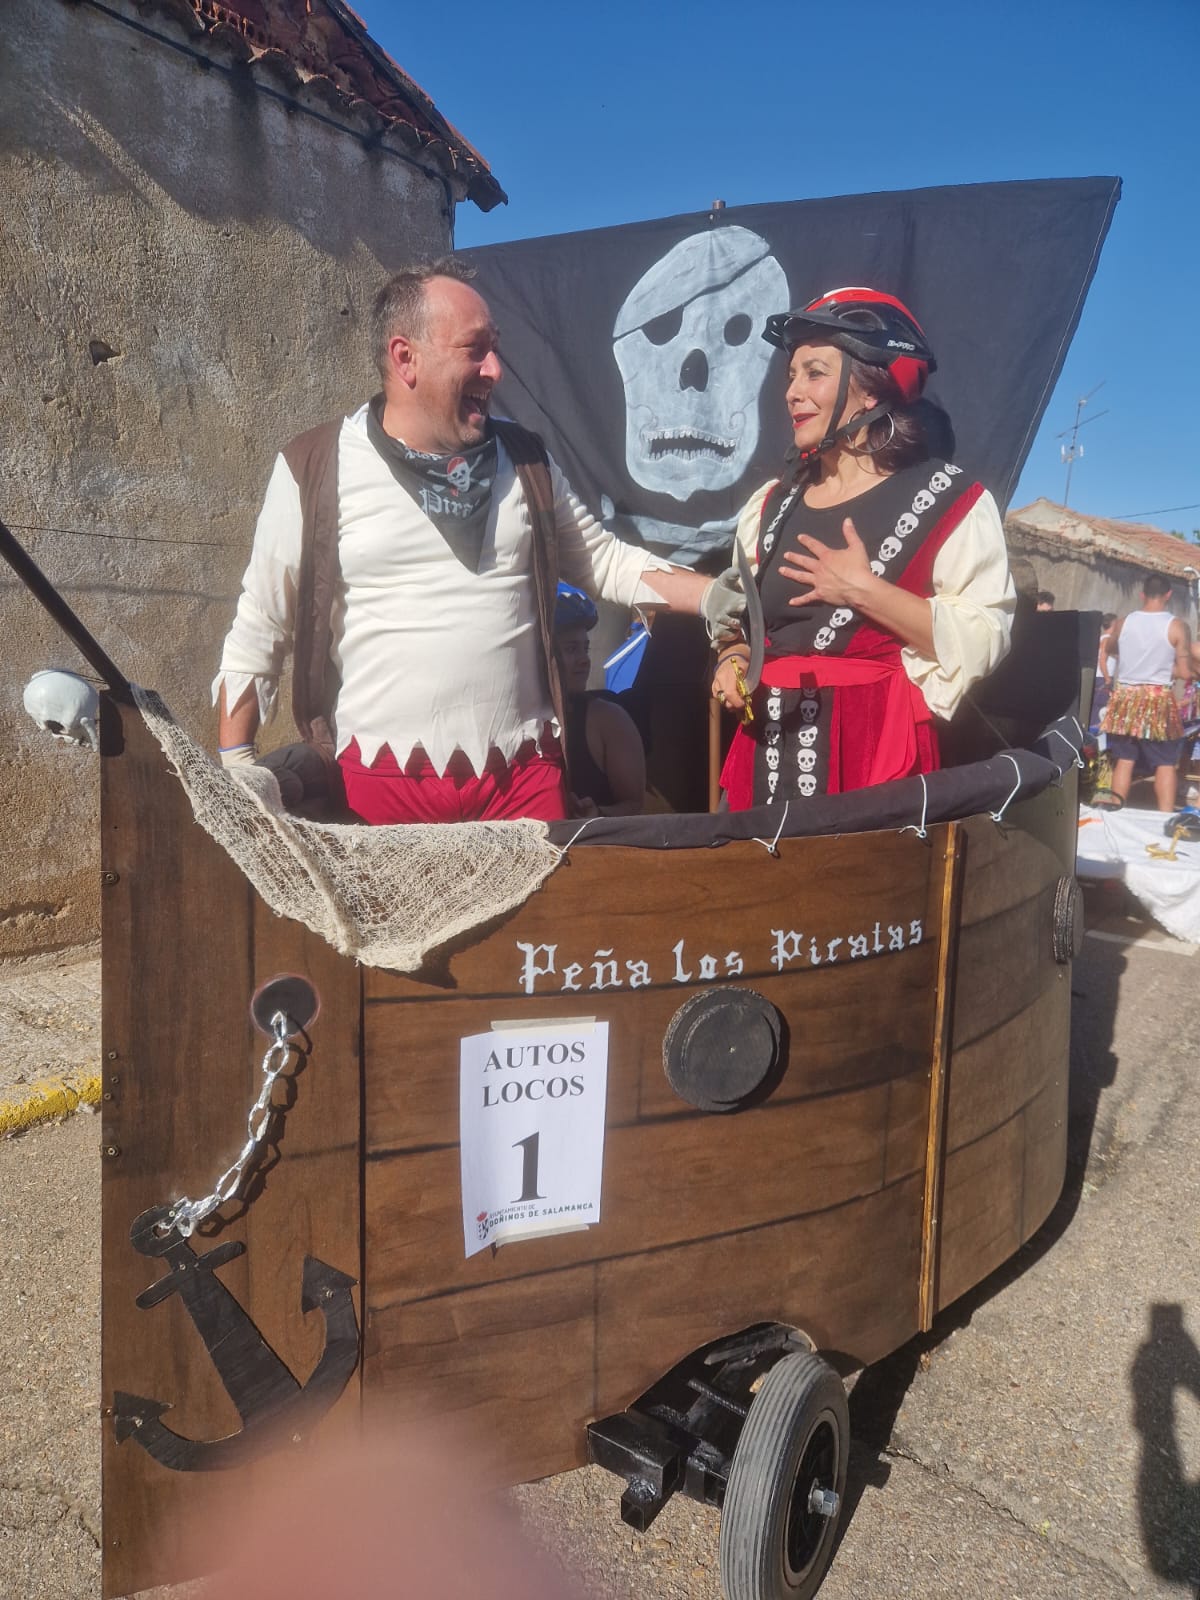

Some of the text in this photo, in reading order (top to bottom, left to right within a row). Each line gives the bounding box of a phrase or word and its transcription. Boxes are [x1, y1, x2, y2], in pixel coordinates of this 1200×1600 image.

[516, 940, 652, 994] Peña
[770, 919, 923, 972] Piratas
[483, 1041, 586, 1073] AUTOS
[482, 1075, 585, 1108] LOCOS
[510, 1131, 547, 1204] 1
[489, 1202, 594, 1228] DOÑINOS DE SALAMANCA
